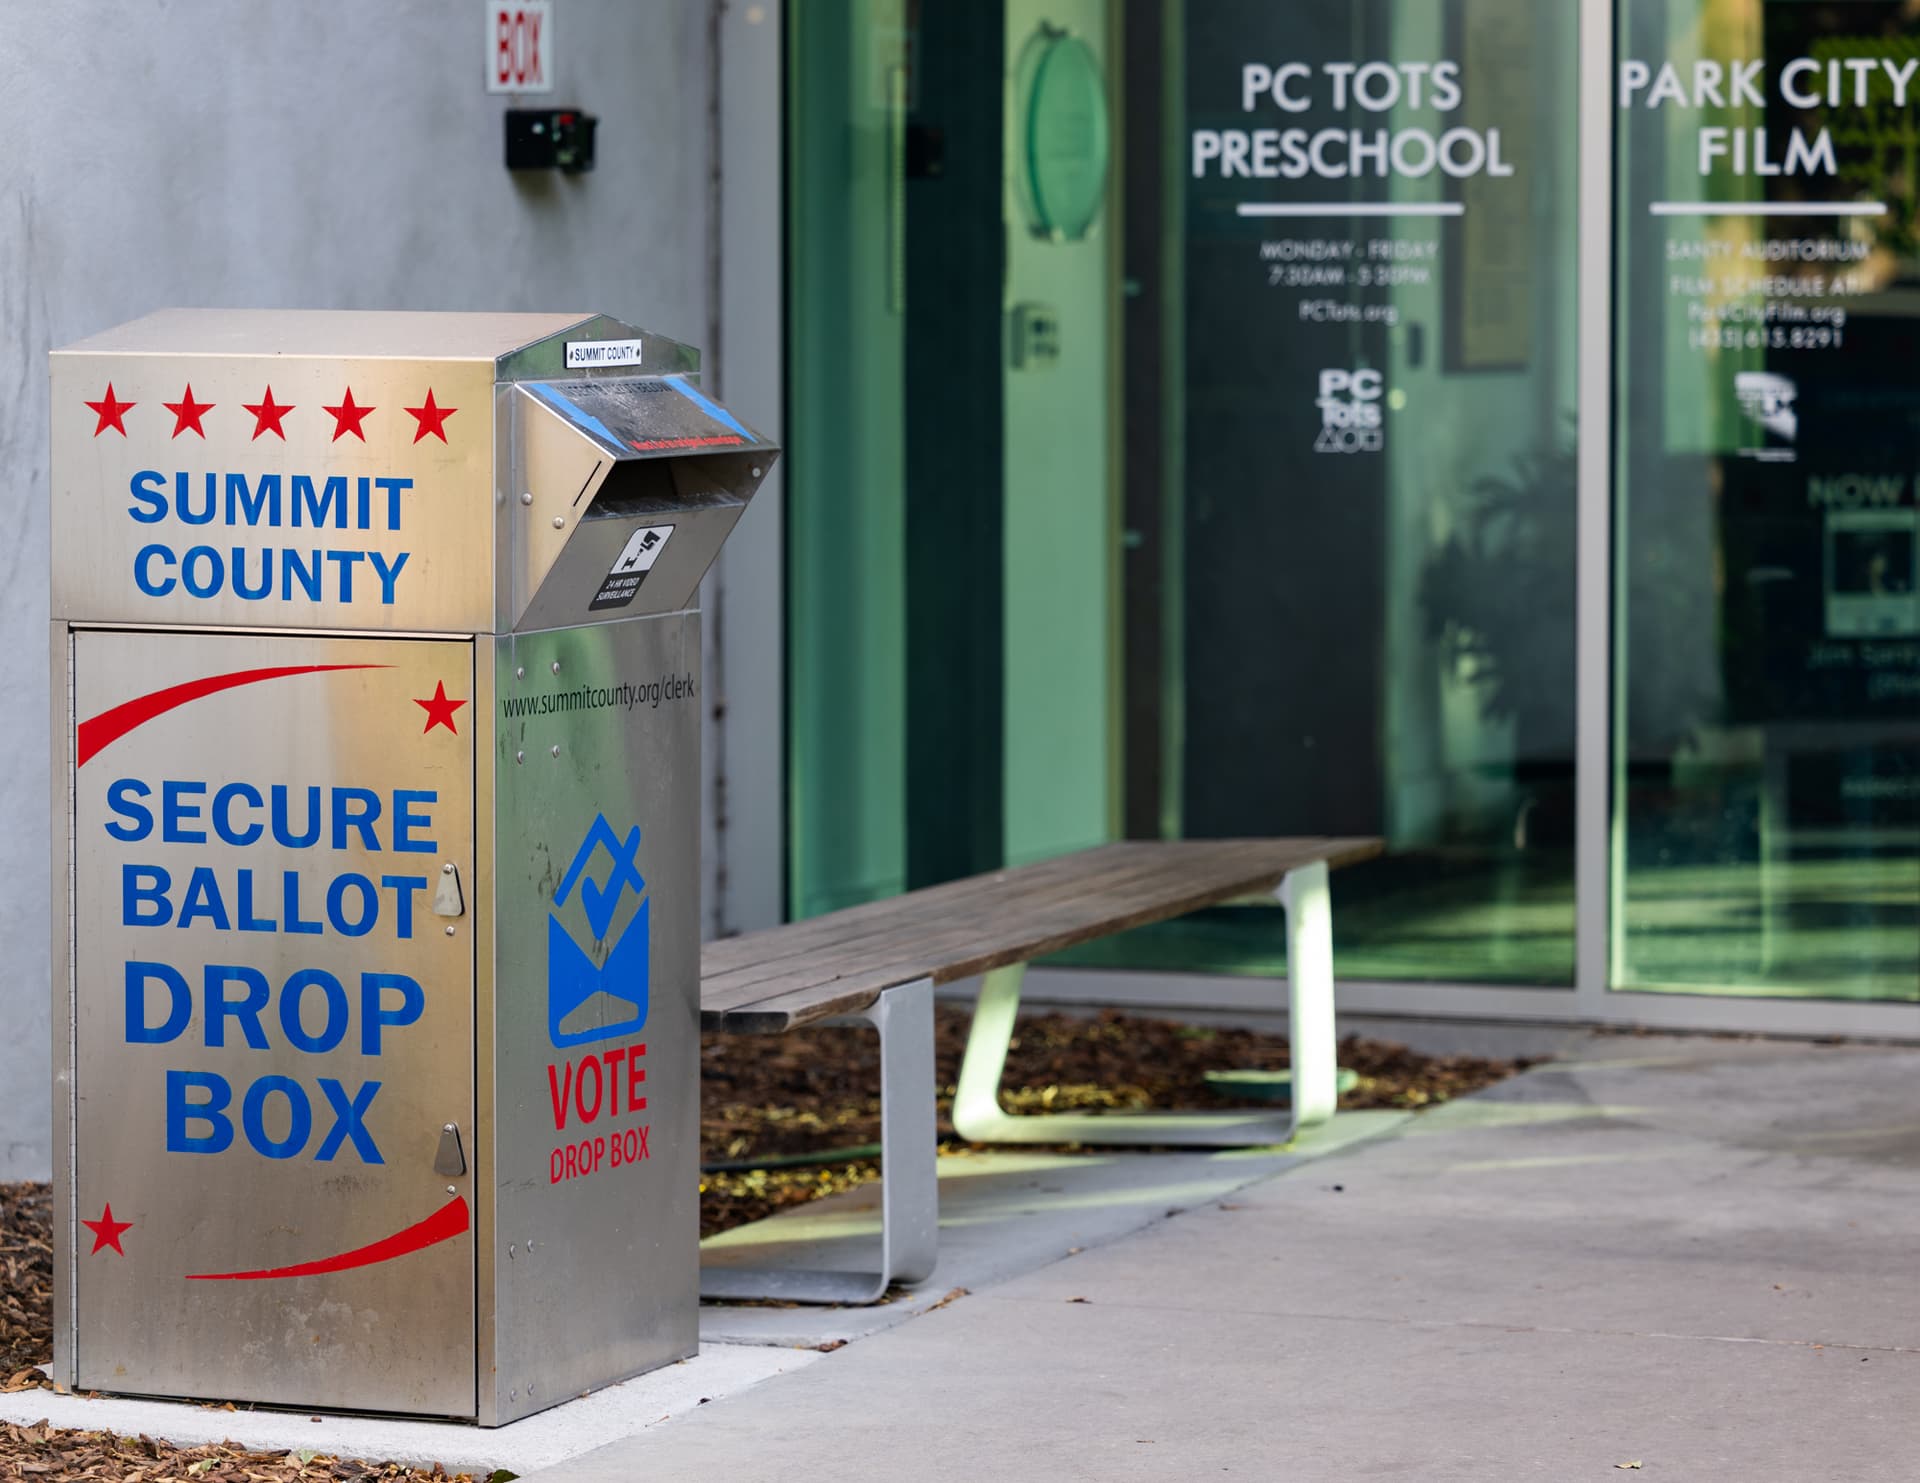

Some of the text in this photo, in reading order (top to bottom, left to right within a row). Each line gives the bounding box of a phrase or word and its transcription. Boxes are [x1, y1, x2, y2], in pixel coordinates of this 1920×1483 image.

[498, 11, 544, 85] BOX
[1242, 62, 1462, 112] PC TOTS
[1620, 58, 1919, 109] PARK CITY
[1192, 128, 1513, 178] PRESCHOOL
[1698, 126, 1837, 176] FILM
[1261, 240, 1355, 260] MONDAY
[1368, 240, 1438, 260] FRIDAY
[1741, 240, 1869, 261] AUDITORIUM
[1670, 276, 1714, 296] FILM
[1722, 276, 1825, 297] SCHEDULE
[575, 346, 634, 361] SUMMIT COUNTY
[1318, 369, 1382, 400] PC
[1316, 400, 1381, 428] Tots
[128, 470, 413, 531] SUMMIT
[134, 544, 410, 605] COUNTY
[596, 588, 636, 601] SURVEILLANCE
[503, 672, 695, 718] www.summitcounty.org/clerk
[105, 778, 438, 853] SECURE
[122, 864, 427, 939] BALLOT
[125, 961, 424, 1056] DROP
[548, 1044, 647, 1130] VOTE
[166, 1070, 386, 1165] BOX
[550, 1126, 650, 1184] DROP BOX
